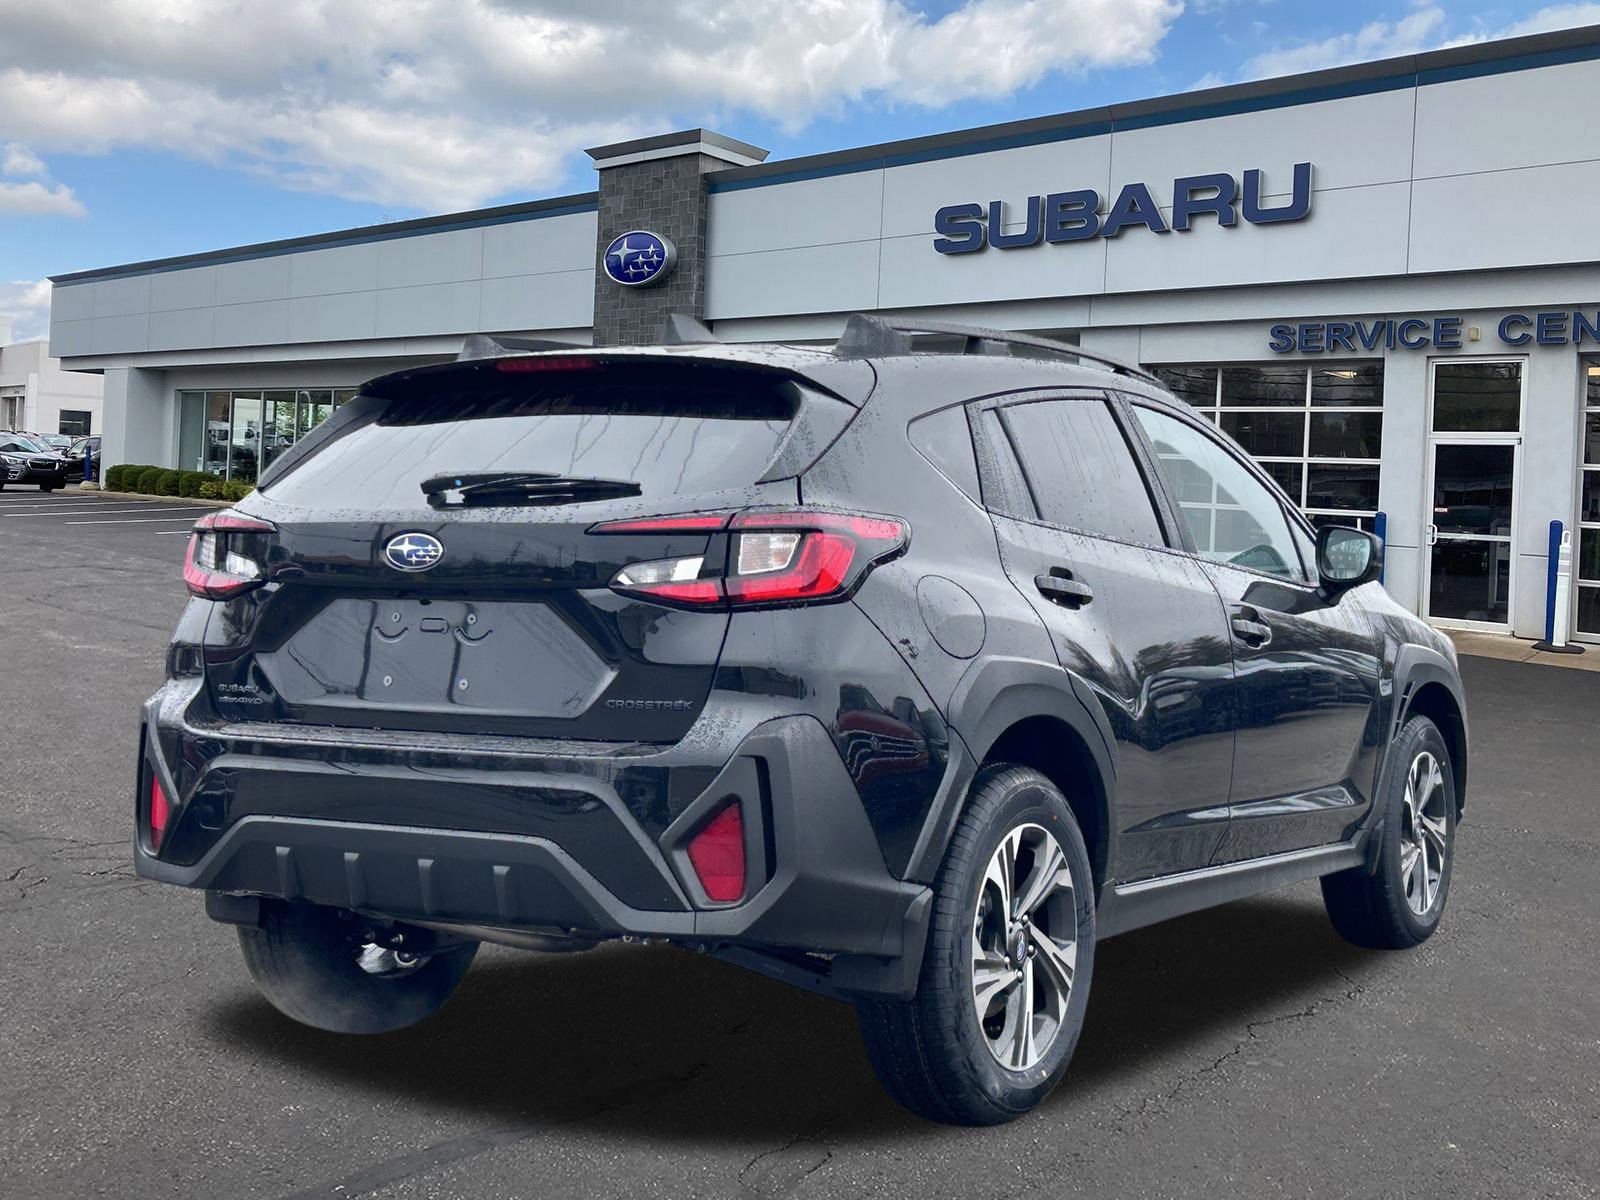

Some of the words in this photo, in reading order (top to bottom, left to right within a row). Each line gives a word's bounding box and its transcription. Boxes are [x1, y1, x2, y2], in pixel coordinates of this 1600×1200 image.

[934, 162, 1313, 254] SUBARU
[1269, 317, 1463, 353] SERVICE
[1498, 311, 1600, 346] CEN
[218, 683, 259, 694] SUBARU
[606, 699, 693, 710] CROSSTREK
